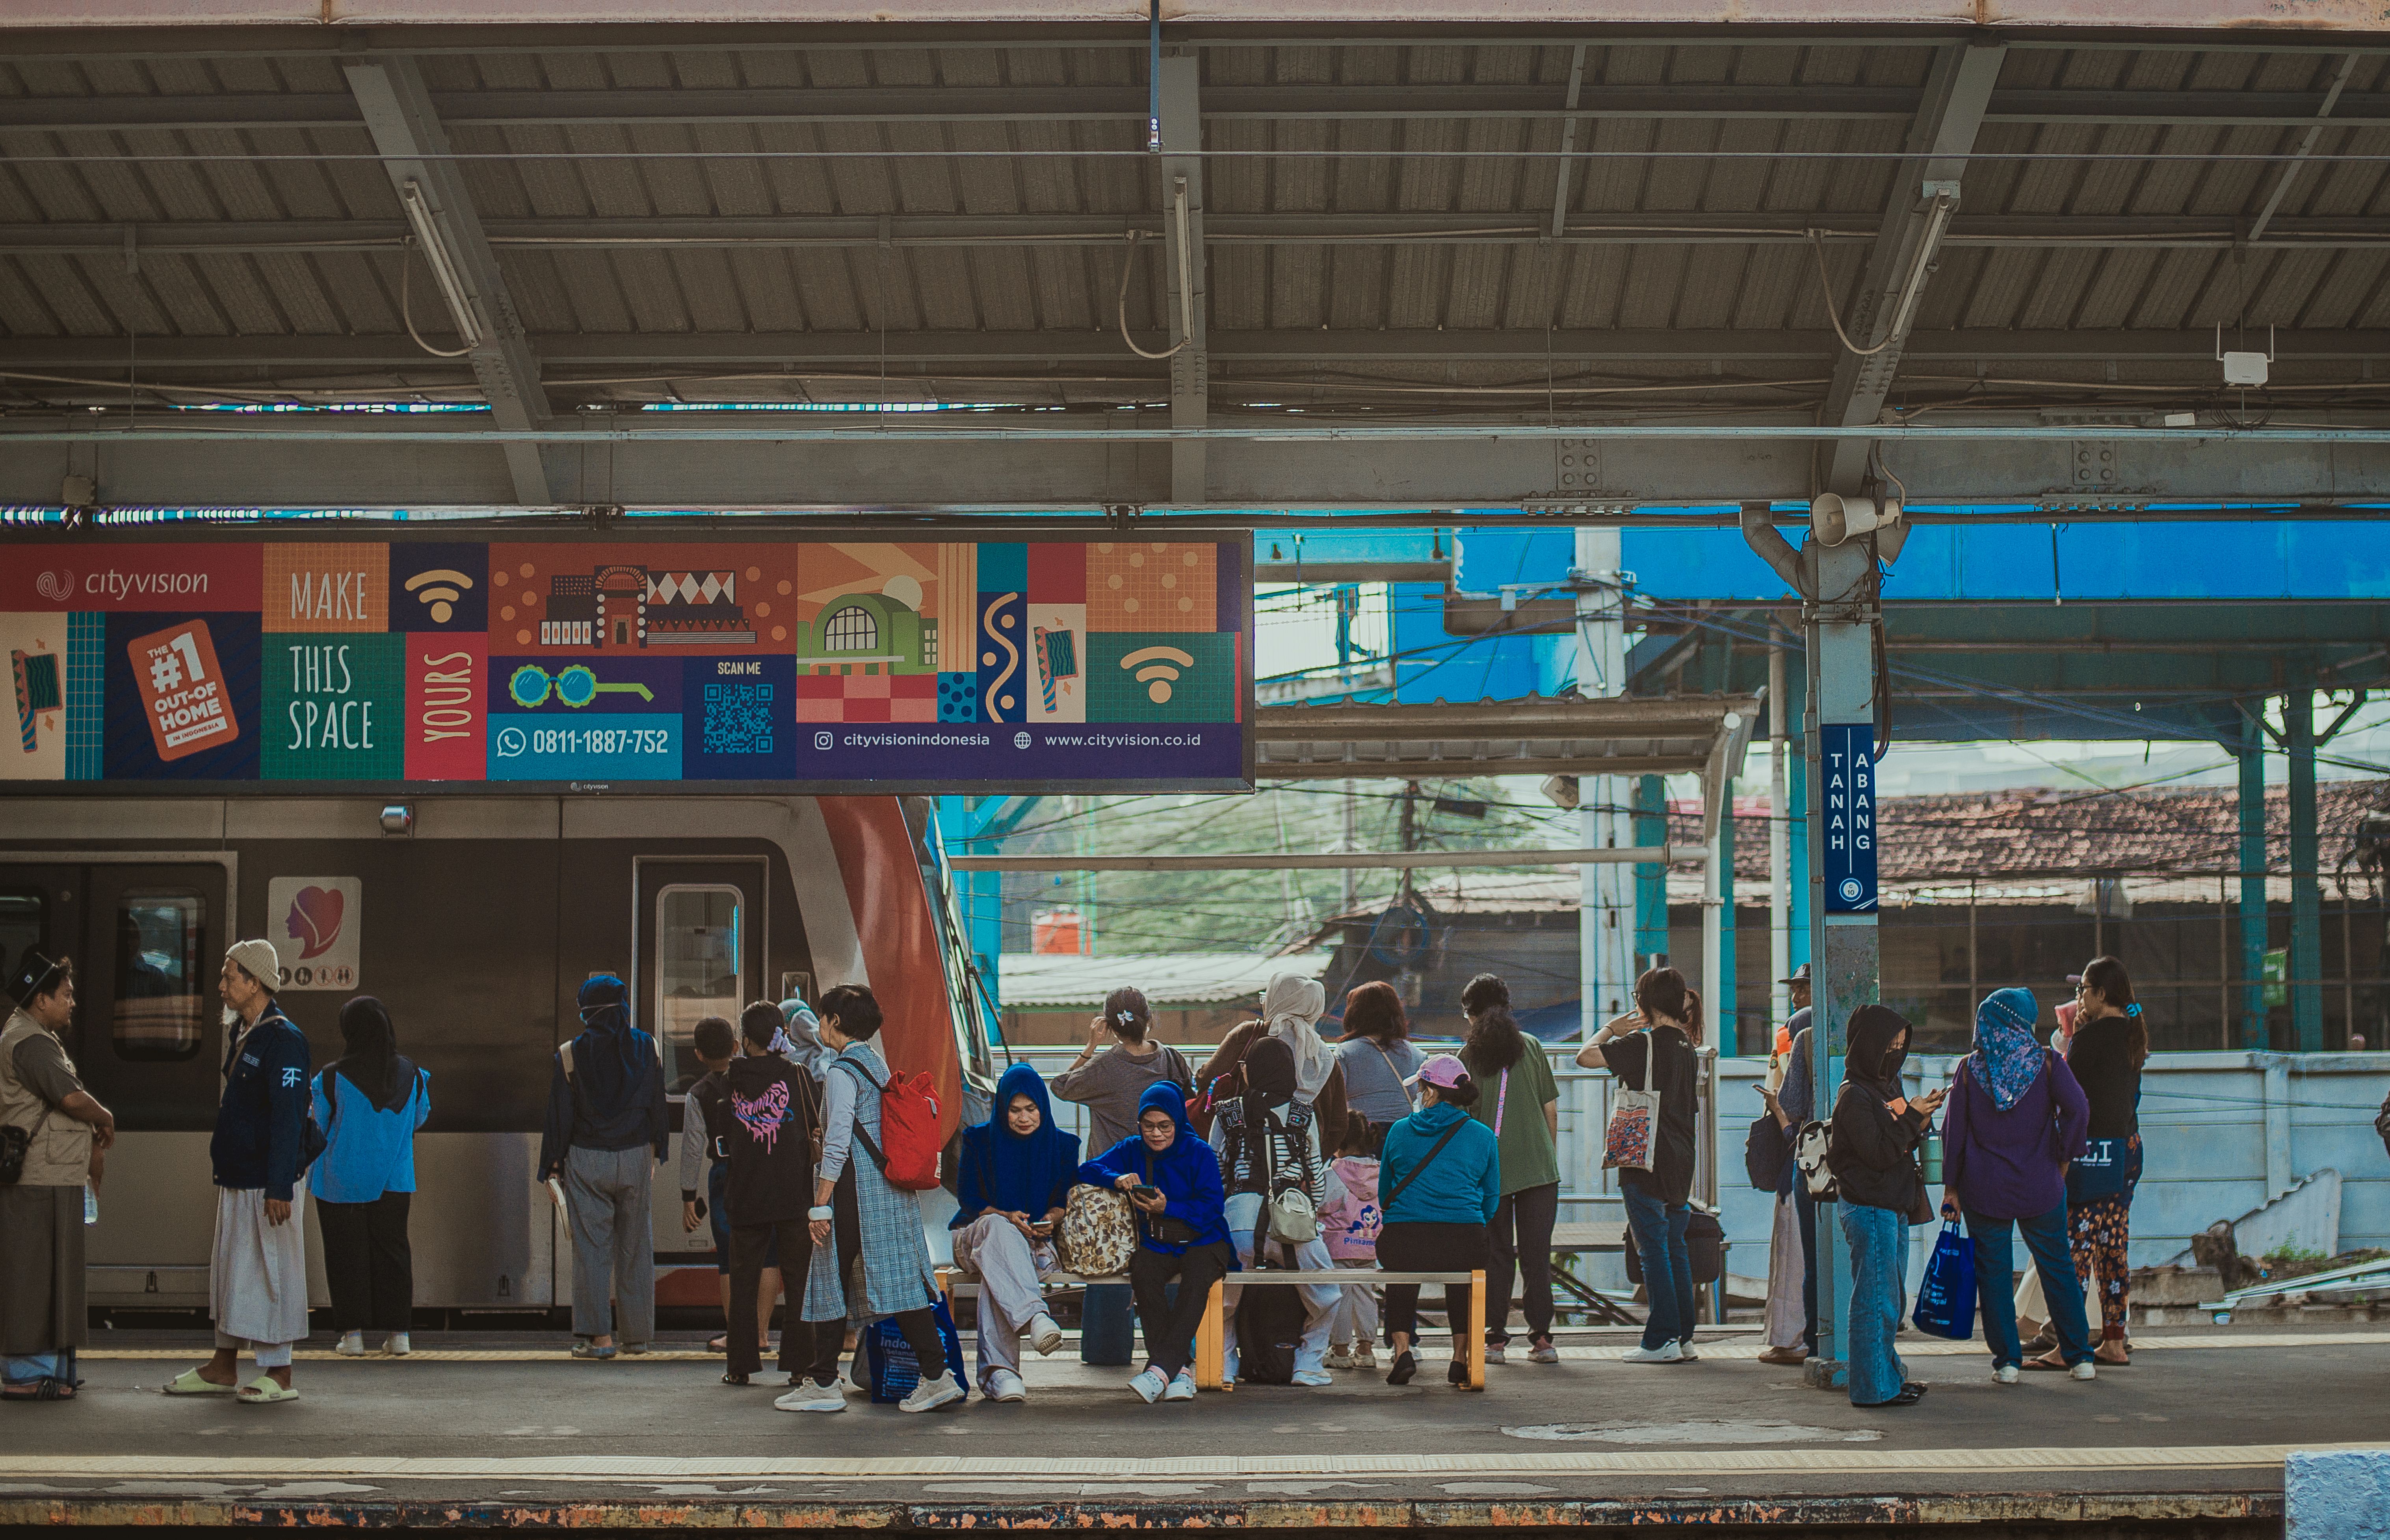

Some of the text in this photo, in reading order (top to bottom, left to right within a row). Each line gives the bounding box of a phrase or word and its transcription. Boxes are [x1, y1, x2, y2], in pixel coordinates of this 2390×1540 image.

[85, 569, 208, 600] cityvision
[291, 571, 367, 621] MAKE
[147, 645, 169, 658] THE
[150, 632, 205, 693] #1
[718, 662, 761, 674] SCAN ME
[289, 645, 351, 694] THIS
[154, 681, 216, 713] OUT-OF
[423, 652, 472, 743] YOURS
[159, 697, 222, 732] HOME
[182, 722, 219, 739] INDONESIA
[288, 700, 374, 749] SPACE
[533, 729, 668, 754] 0811-1887-752
[844, 733, 989, 747] cityvisionindonesia
[1045, 733, 1201, 747] www.cityvision.co.id
[1830, 753, 1844, 850] TANAH
[1855, 753, 1870, 850] ABANG
